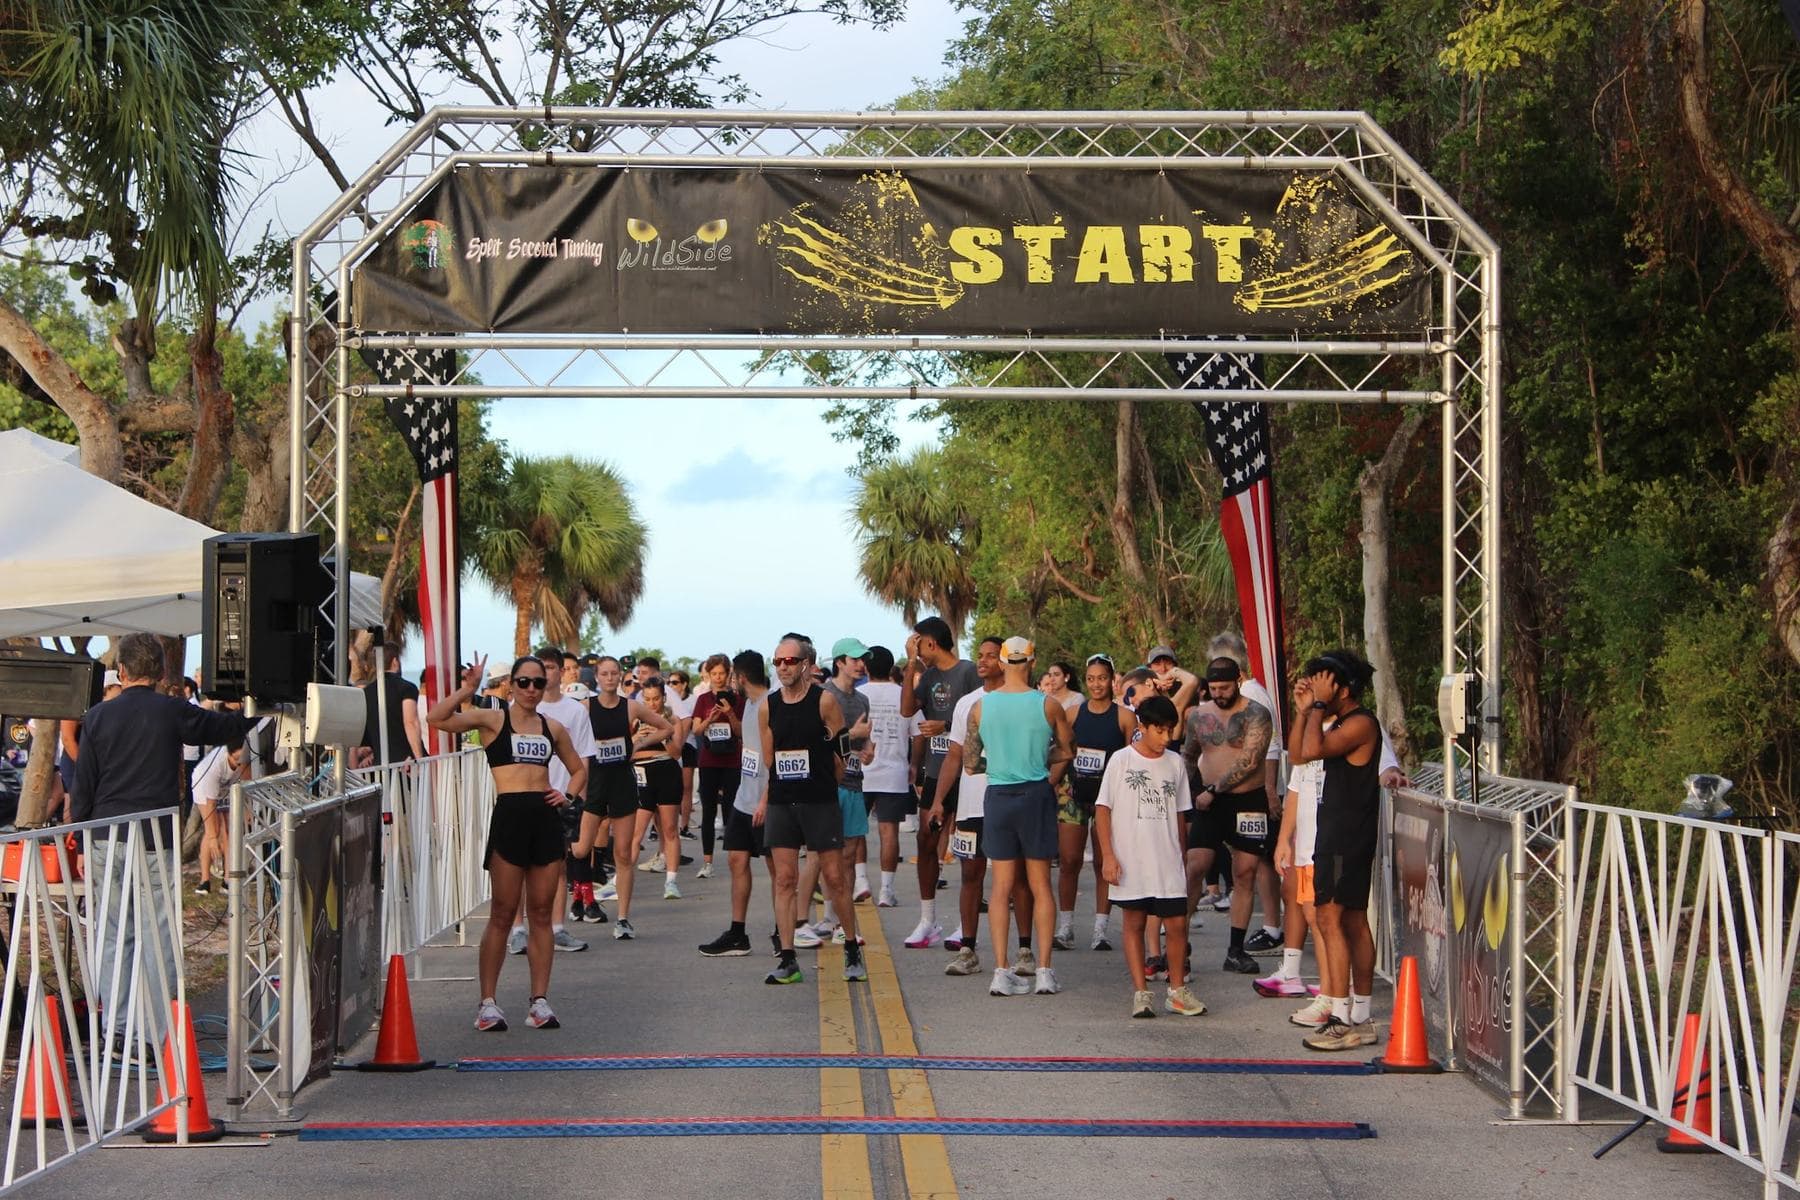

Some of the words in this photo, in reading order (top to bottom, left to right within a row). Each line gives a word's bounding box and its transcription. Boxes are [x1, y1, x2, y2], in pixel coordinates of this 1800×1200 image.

[464, 237, 502, 262] Split
[505, 236, 557, 262] Second
[561, 238, 603, 267] Timing
[616, 235, 732, 271] WildSide
[949, 225, 1254, 284] START
[517, 742, 548, 757] 6739
[598, 745, 623, 758] 7840
[778, 759, 807, 773] 6662
[1076, 756, 1101, 769] 6670
[1240, 821, 1266, 833] 6659
